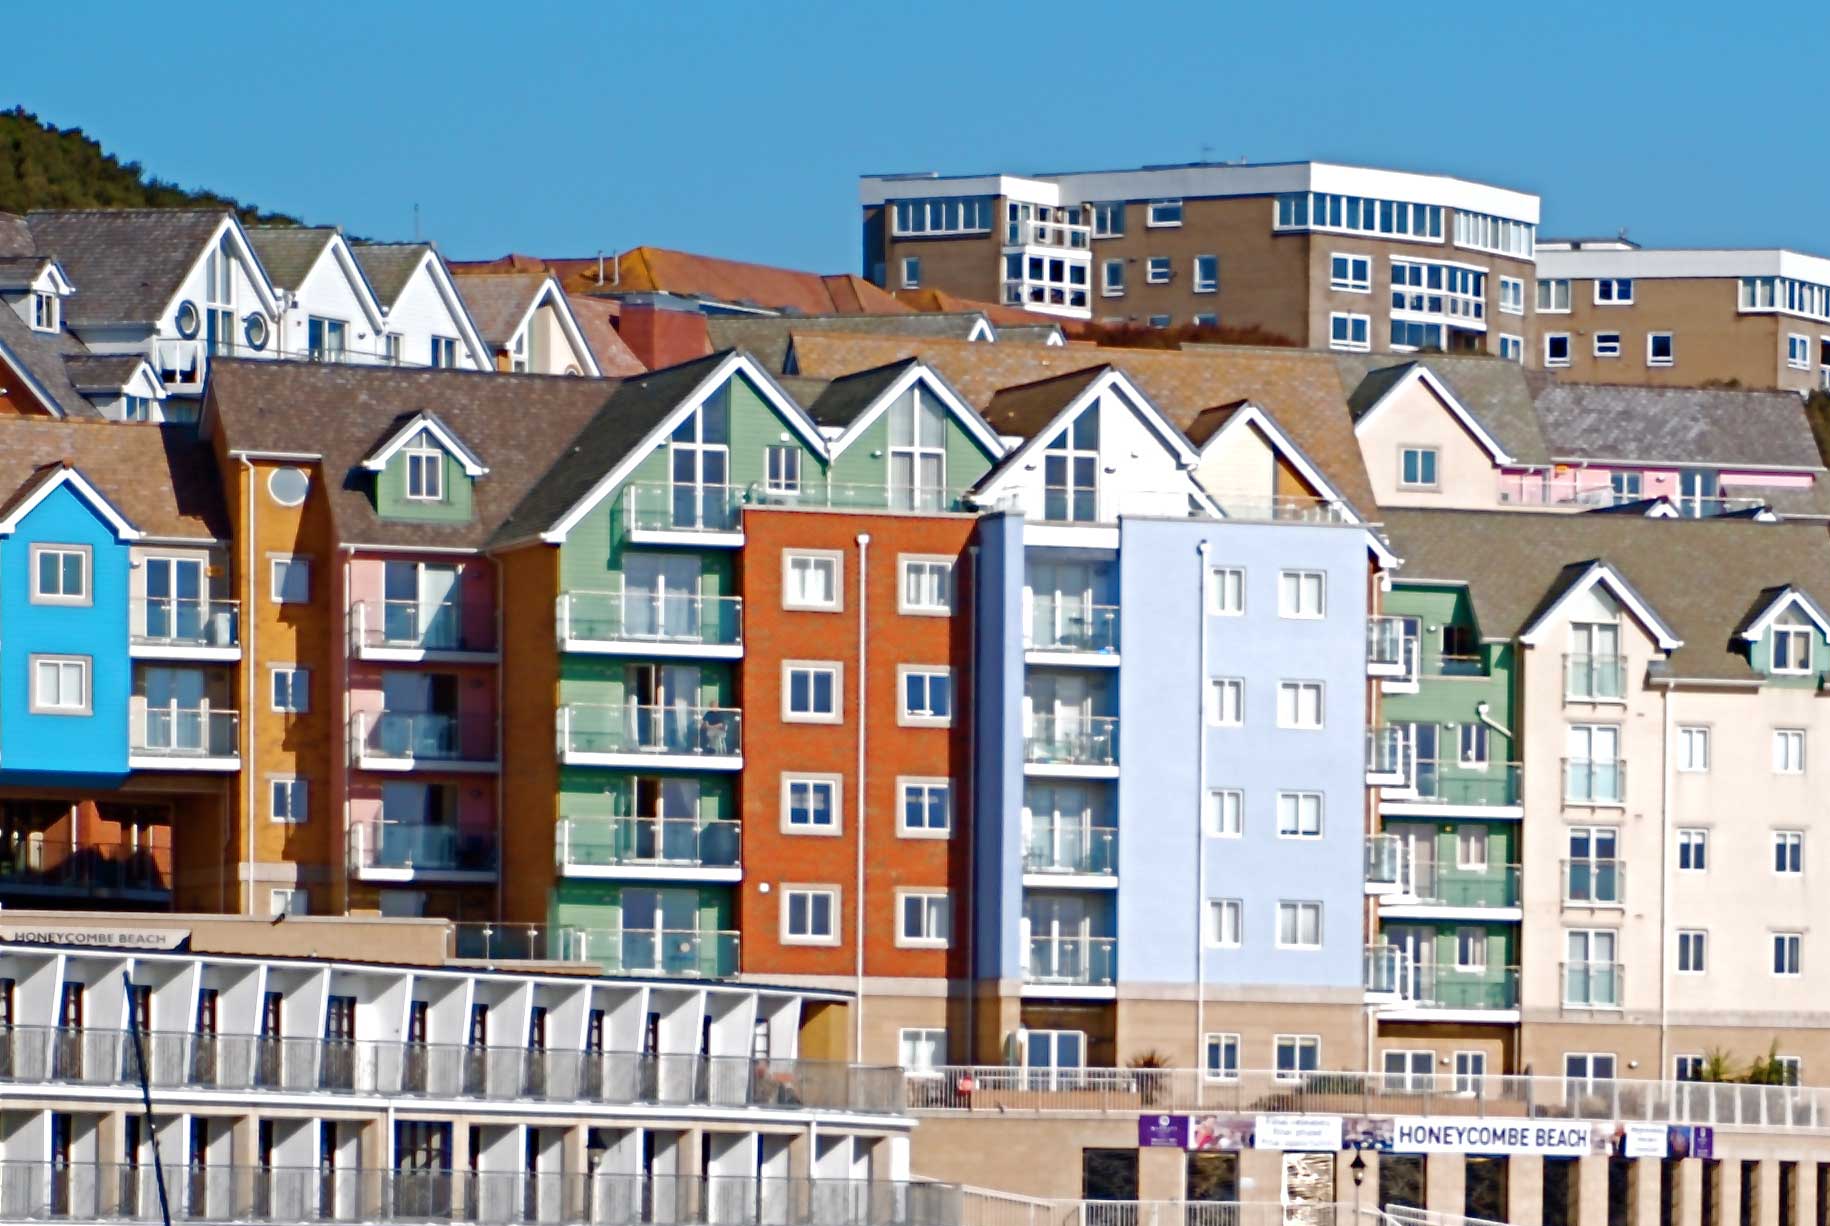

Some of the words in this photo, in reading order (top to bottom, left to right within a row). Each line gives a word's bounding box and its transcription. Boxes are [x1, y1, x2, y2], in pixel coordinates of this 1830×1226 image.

[14, 932, 114, 944] HONEYCOMBE
[119, 934, 166, 944] BEACH
[1399, 1125, 1530, 1147] HONEYCOMBE
[1535, 1128, 1587, 1147] BEACH
